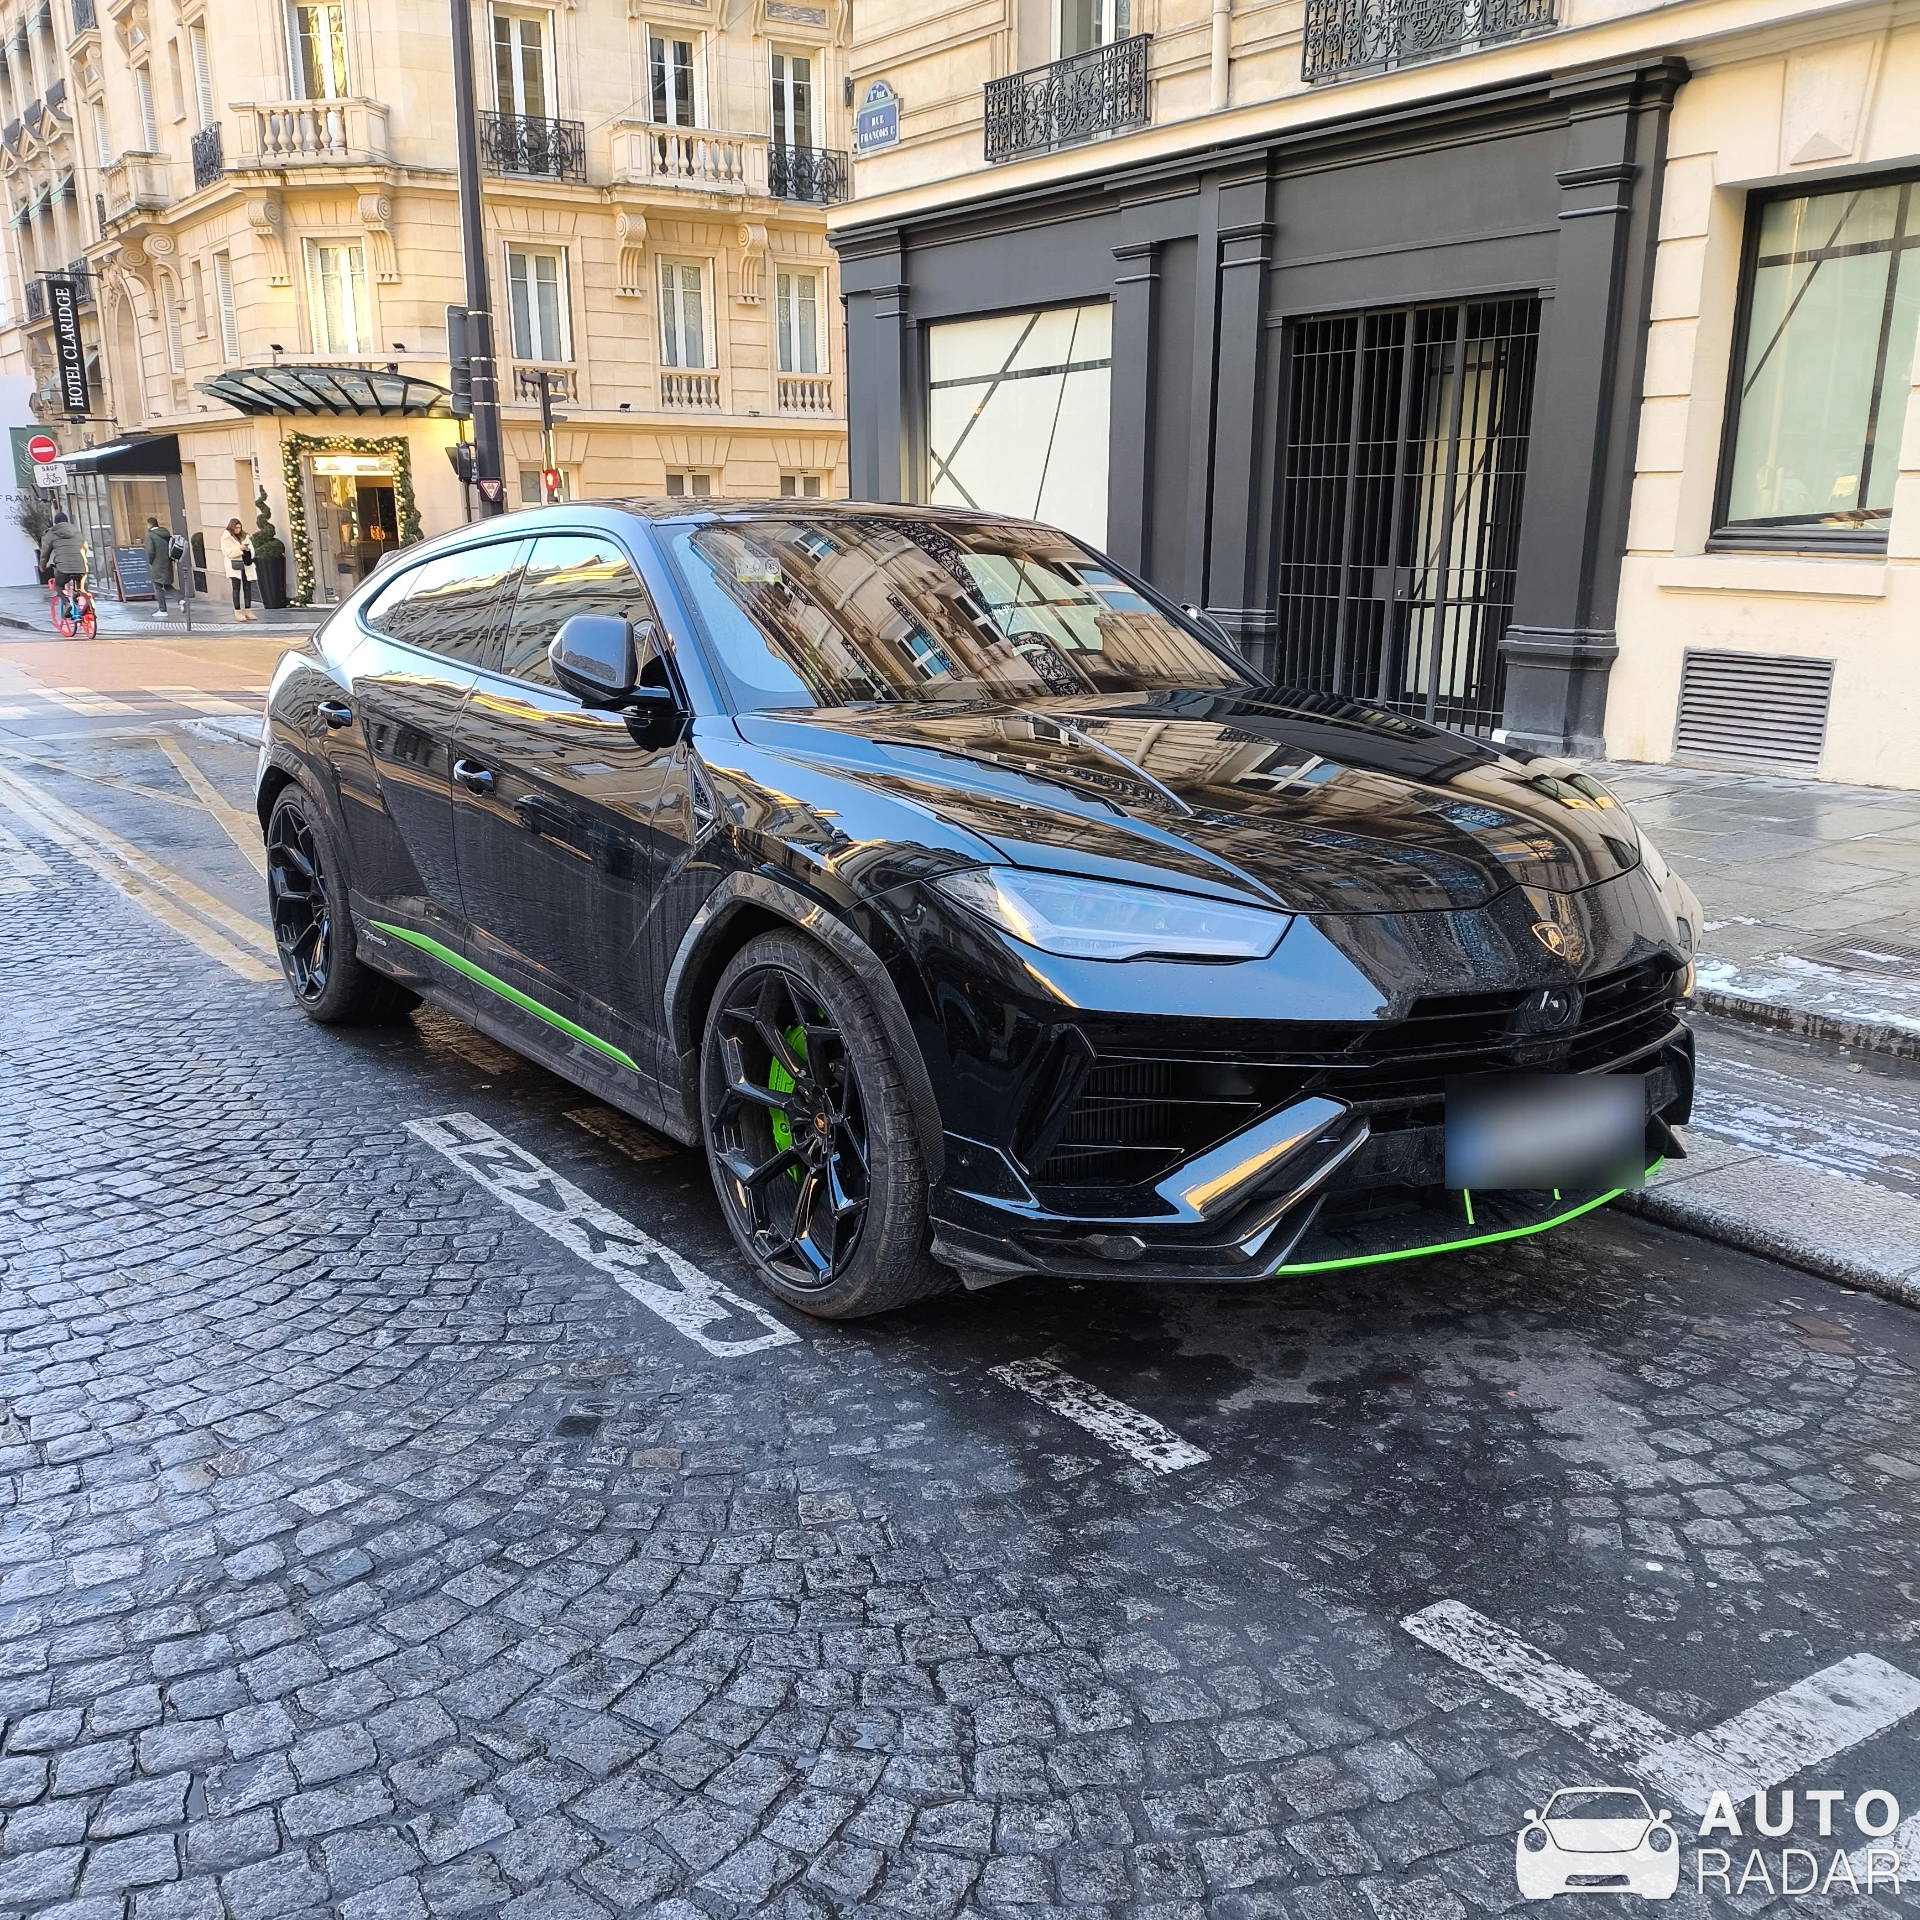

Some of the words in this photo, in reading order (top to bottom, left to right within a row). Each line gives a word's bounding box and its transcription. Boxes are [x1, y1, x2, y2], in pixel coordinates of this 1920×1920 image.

[871, 114, 885, 127] RUE
[860, 126, 889, 143] FRANÇOIS
[55, 287, 77, 360] CLARIDGE
[65, 363, 84, 408] HOTEL
[41, 464, 58, 472] SAUF
